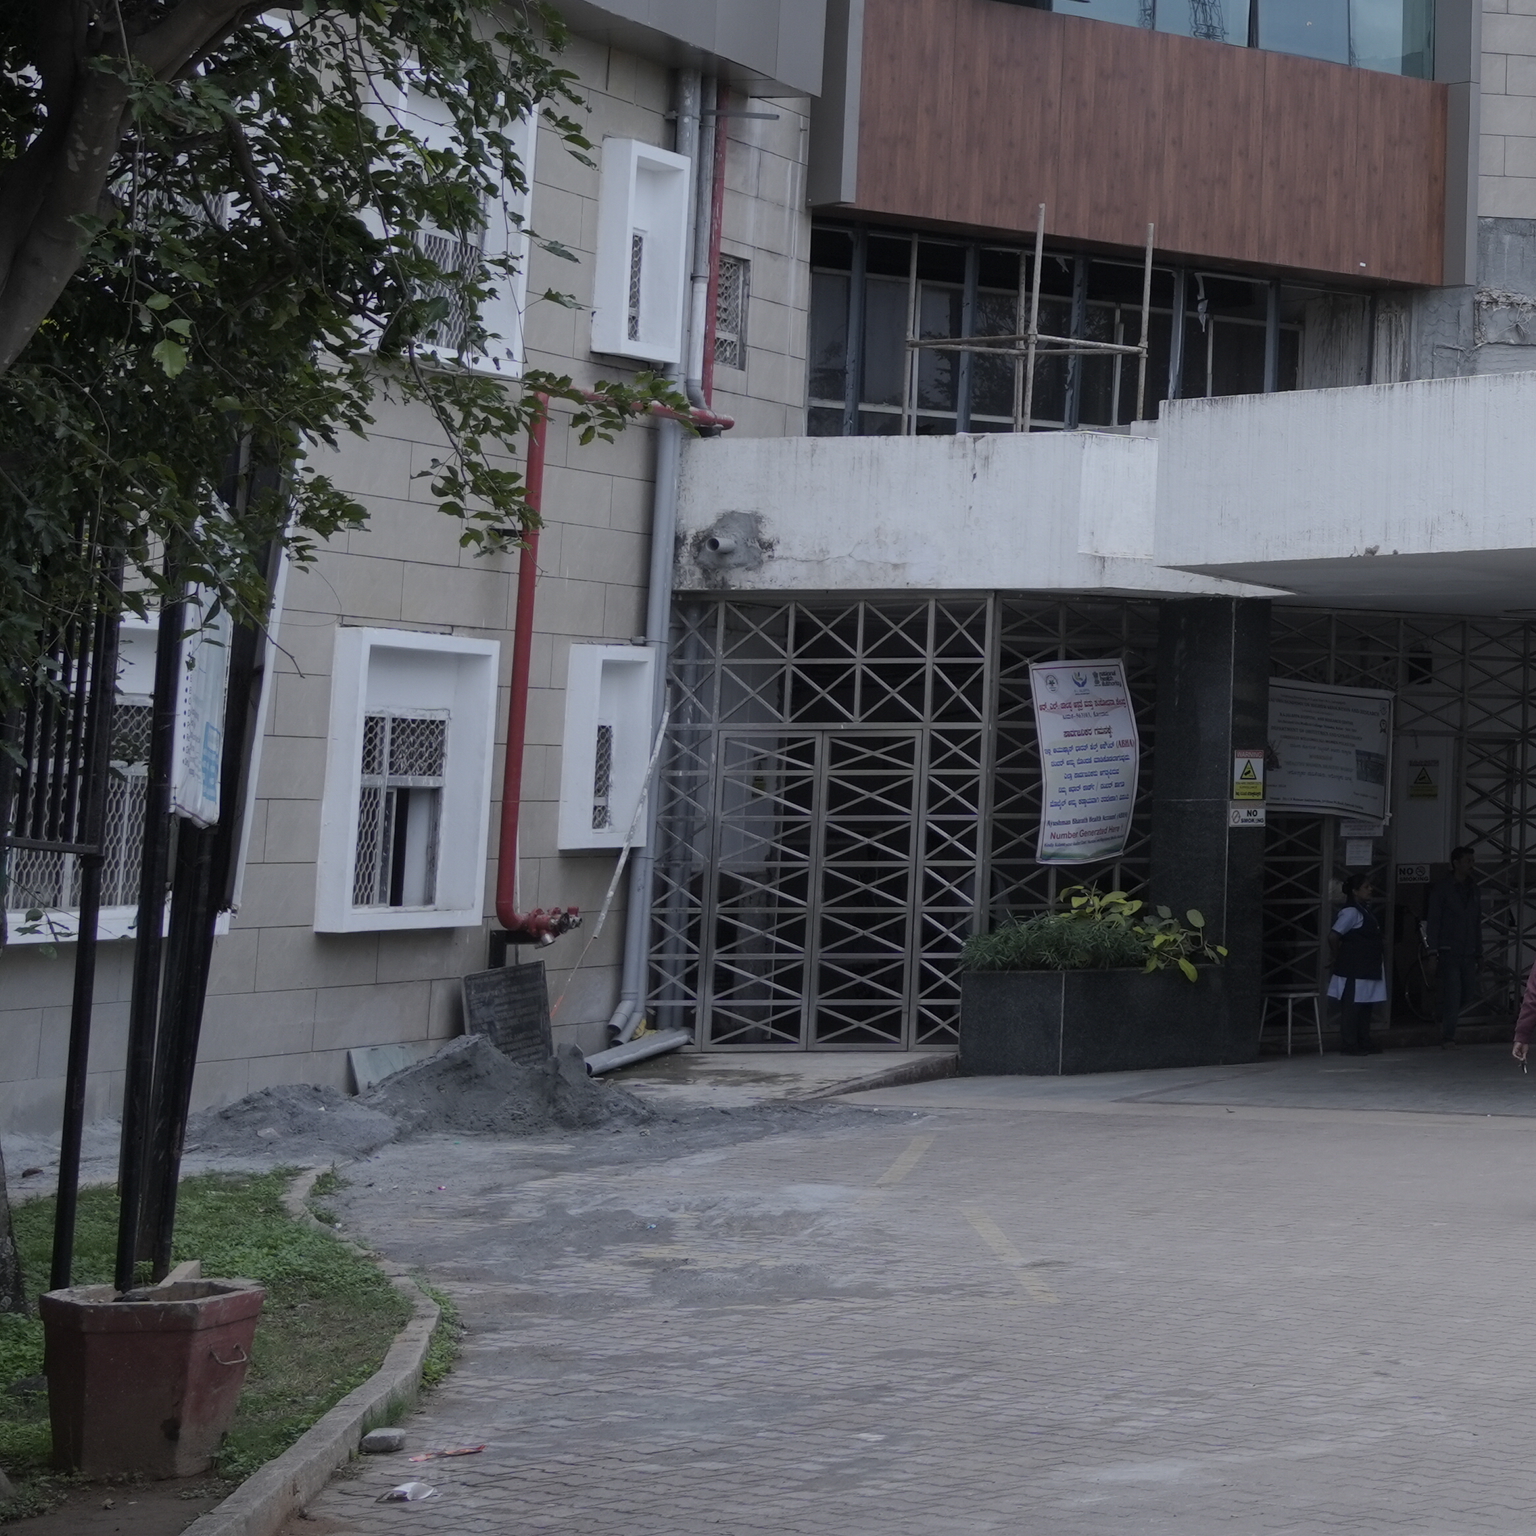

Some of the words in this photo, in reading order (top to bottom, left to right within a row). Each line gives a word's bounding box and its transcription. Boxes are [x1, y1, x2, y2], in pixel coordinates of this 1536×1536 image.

[1050, 831, 1078, 839] Number
[1079, 827, 1107, 837] Generated
[1108, 825, 1120, 833] Here
